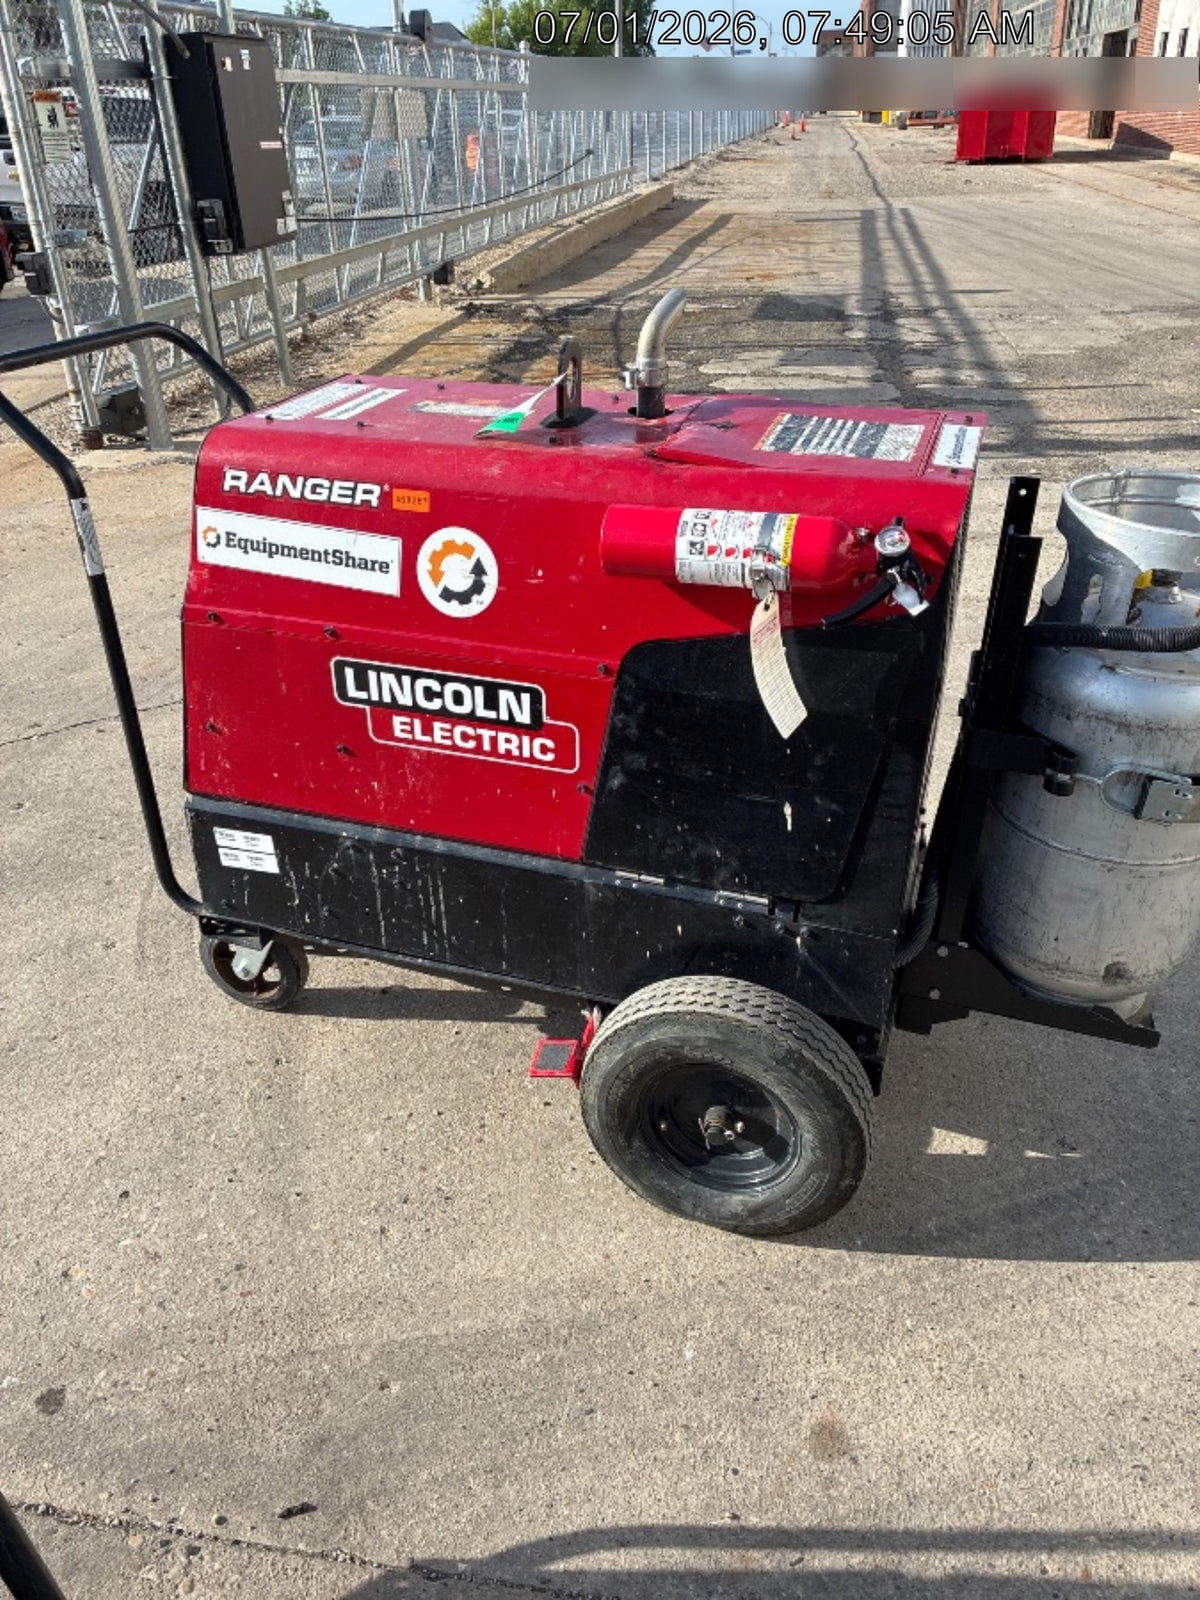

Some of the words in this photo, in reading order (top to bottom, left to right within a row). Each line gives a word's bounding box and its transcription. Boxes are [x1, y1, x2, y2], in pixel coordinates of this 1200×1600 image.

[223, 468, 381, 507] RANGER
[225, 531, 391, 575] EquipmentShare
[343, 666, 532, 726] LINCOLN
[391, 714, 557, 763] ELECTRIC
